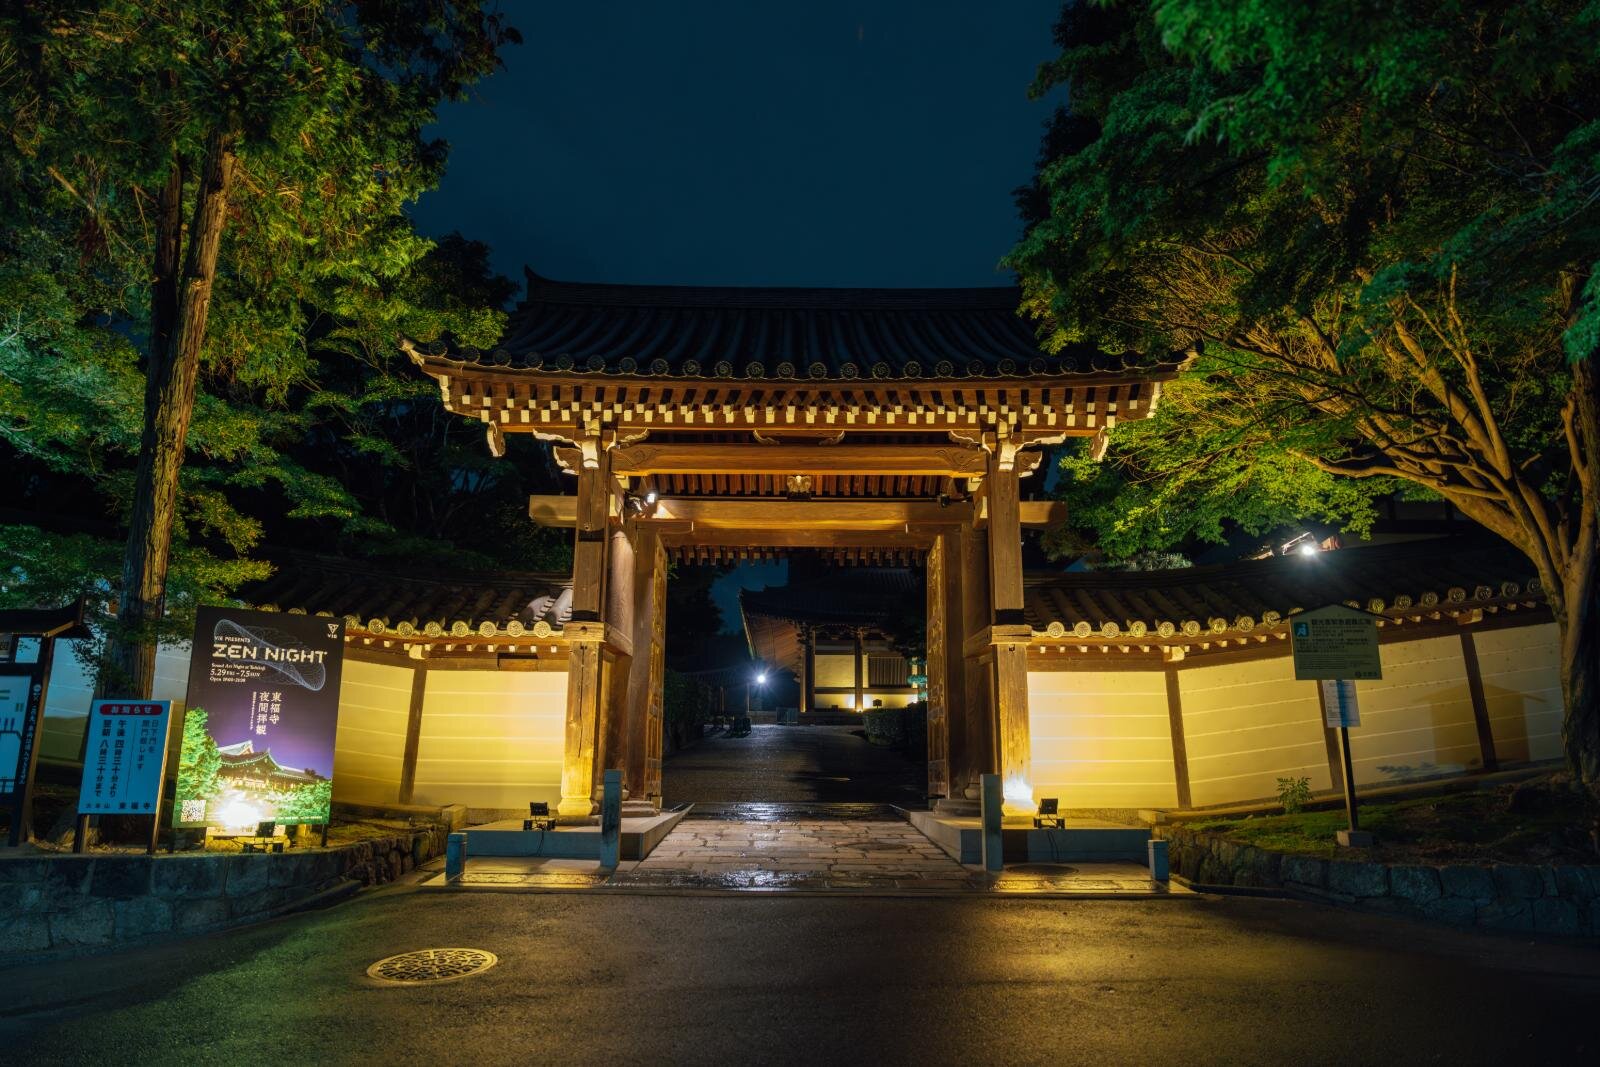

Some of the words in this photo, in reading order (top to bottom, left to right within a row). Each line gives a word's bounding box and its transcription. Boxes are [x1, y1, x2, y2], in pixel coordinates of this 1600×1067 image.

[212, 644, 257, 660] ZEN
[111, 705, 153, 714] お知らせ
[256, 691, 270, 735] 夜間拝観
[269, 691, 282, 725] 東福寺
